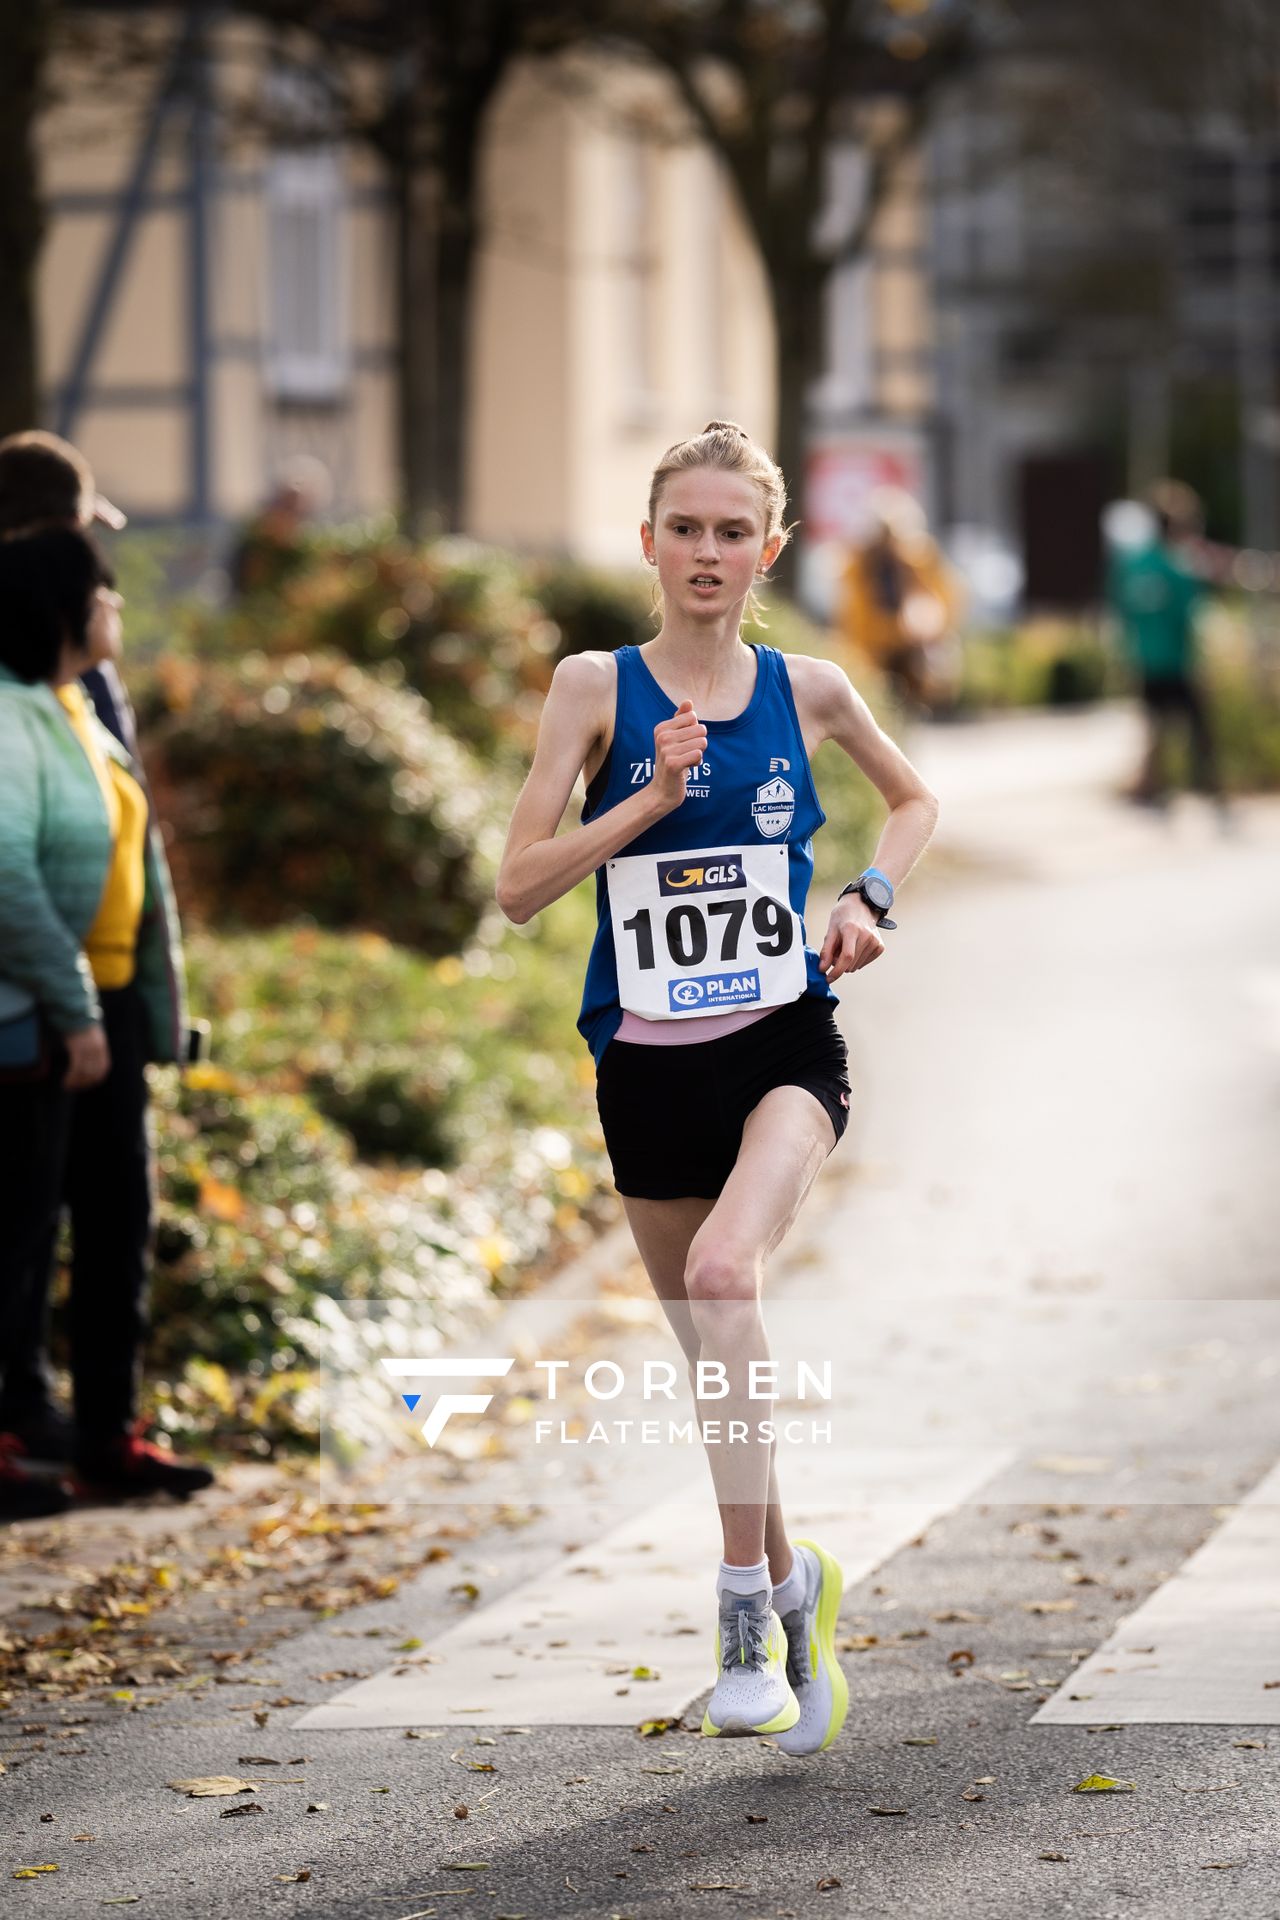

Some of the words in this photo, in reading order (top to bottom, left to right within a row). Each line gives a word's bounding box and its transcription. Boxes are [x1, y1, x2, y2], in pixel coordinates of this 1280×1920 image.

[685, 789, 710, 798] WELT
[754, 805, 767, 813] LAC
[704, 865, 738, 884] GLS
[623, 896, 793, 970] 1079
[706, 976, 757, 995] PLAN
[708, 993, 757, 1003] INTERNATIONAL
